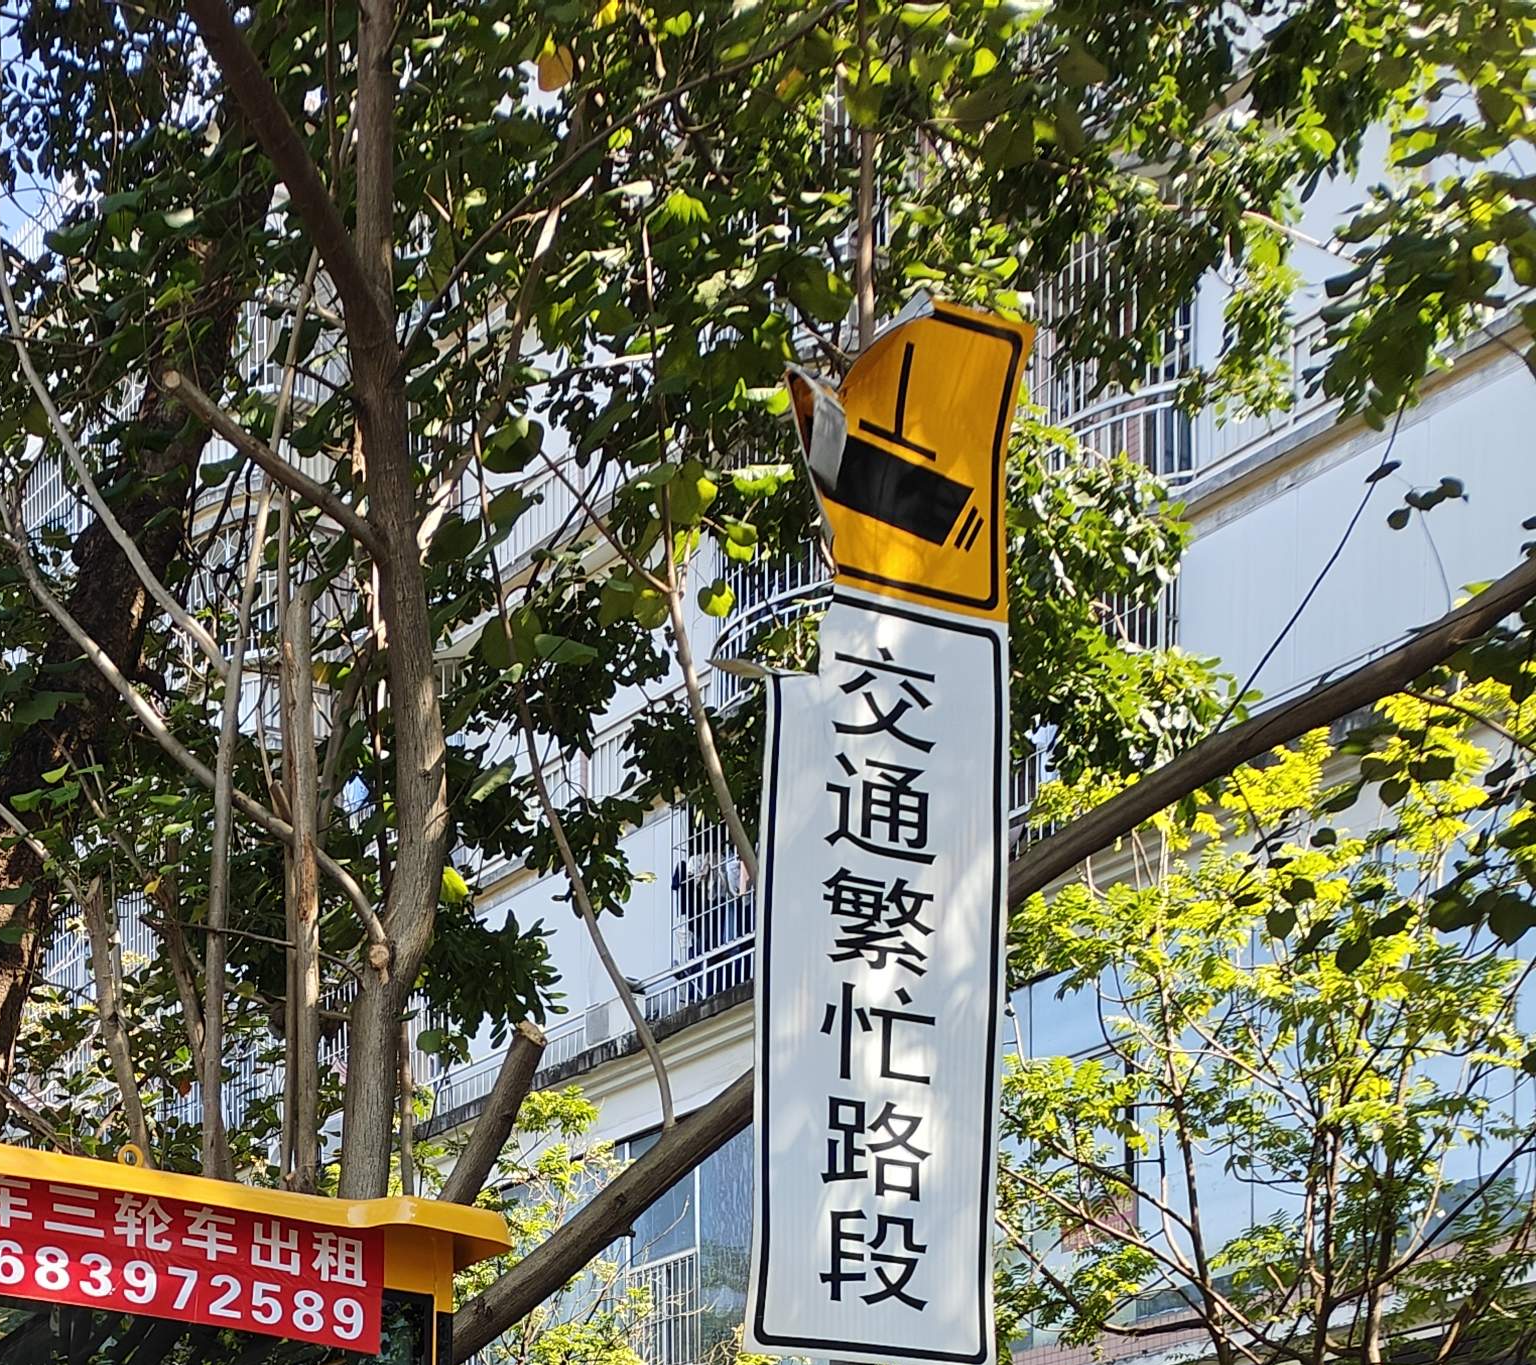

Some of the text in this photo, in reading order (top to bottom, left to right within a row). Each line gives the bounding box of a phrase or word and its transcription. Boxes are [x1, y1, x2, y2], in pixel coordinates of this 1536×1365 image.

[820, 646, 938, 1312] 交通繁忙路段
